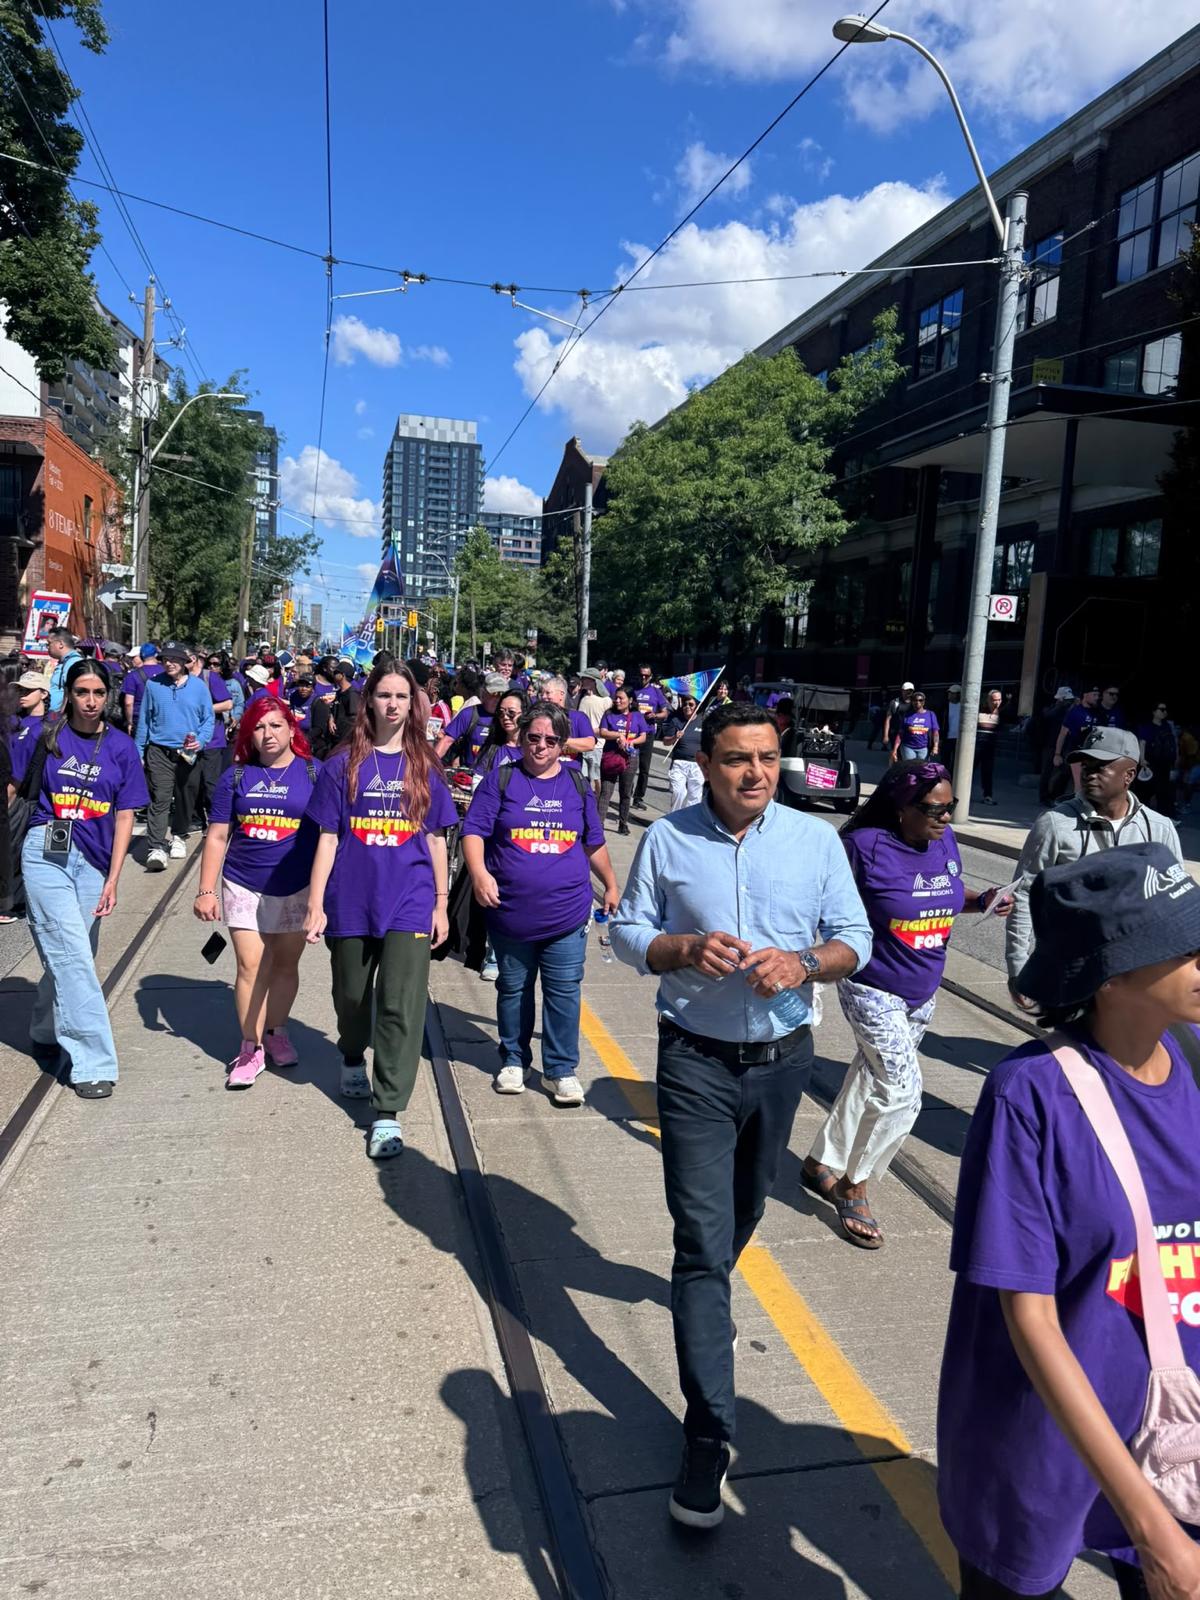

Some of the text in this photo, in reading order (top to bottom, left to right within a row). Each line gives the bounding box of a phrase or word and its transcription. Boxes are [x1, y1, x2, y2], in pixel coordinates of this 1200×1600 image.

[51, 792, 111, 814] IGHTING
[60, 808, 86, 821] FOR
[249, 807, 284, 816] WORTH
[368, 809, 402, 818] WORTH
[530, 820, 563, 829] WORTH
[248, 826, 279, 842] FOR
[366, 833, 399, 847] FOR
[511, 827, 578, 842] FIGHTING
[530, 842, 561, 854] FOR
[919, 908, 953, 918] WORTH
[890, 916, 955, 932] FIGHTIN
[914, 933, 944, 950] FOR
